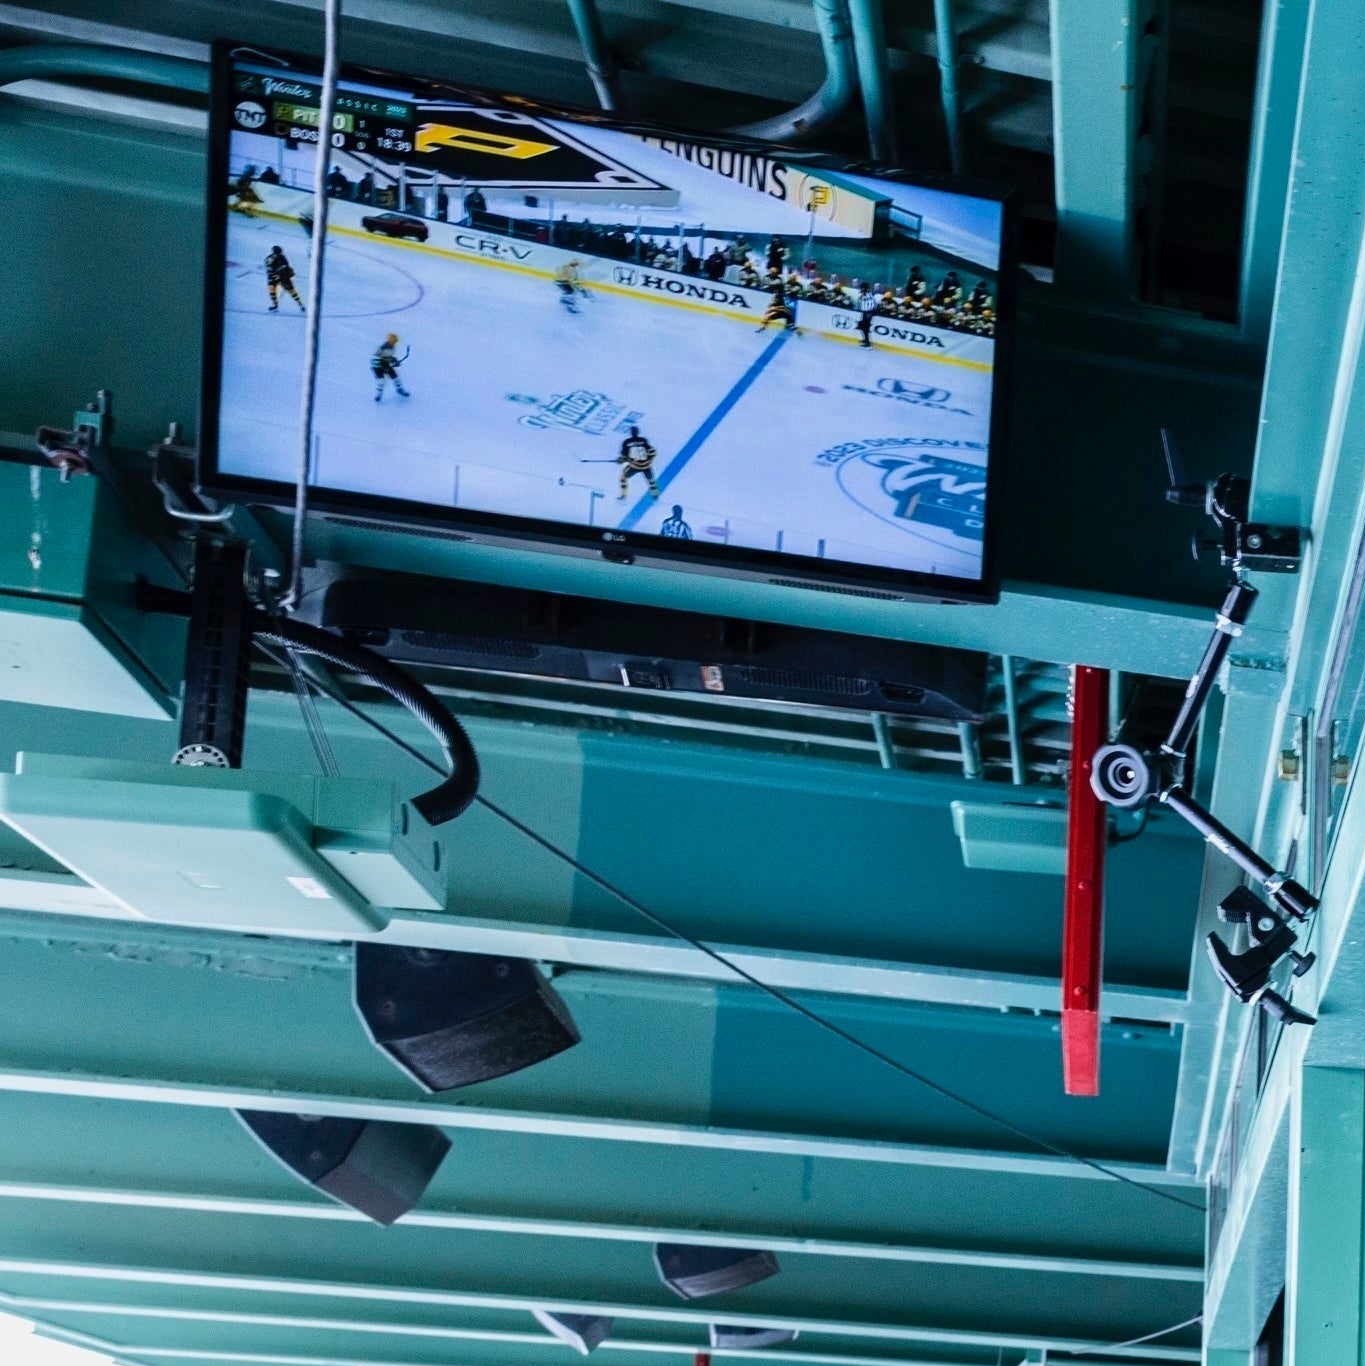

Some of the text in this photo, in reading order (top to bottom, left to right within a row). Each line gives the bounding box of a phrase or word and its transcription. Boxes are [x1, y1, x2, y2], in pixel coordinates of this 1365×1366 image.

[333, 114, 346, 129] 0
[332, 133, 346, 147] 0
[642, 136, 788, 200] ENGUINS
[455, 233, 533, 261] CR-V
[642, 276, 752, 309] HONDA
[856, 320, 946, 348] ONDA
